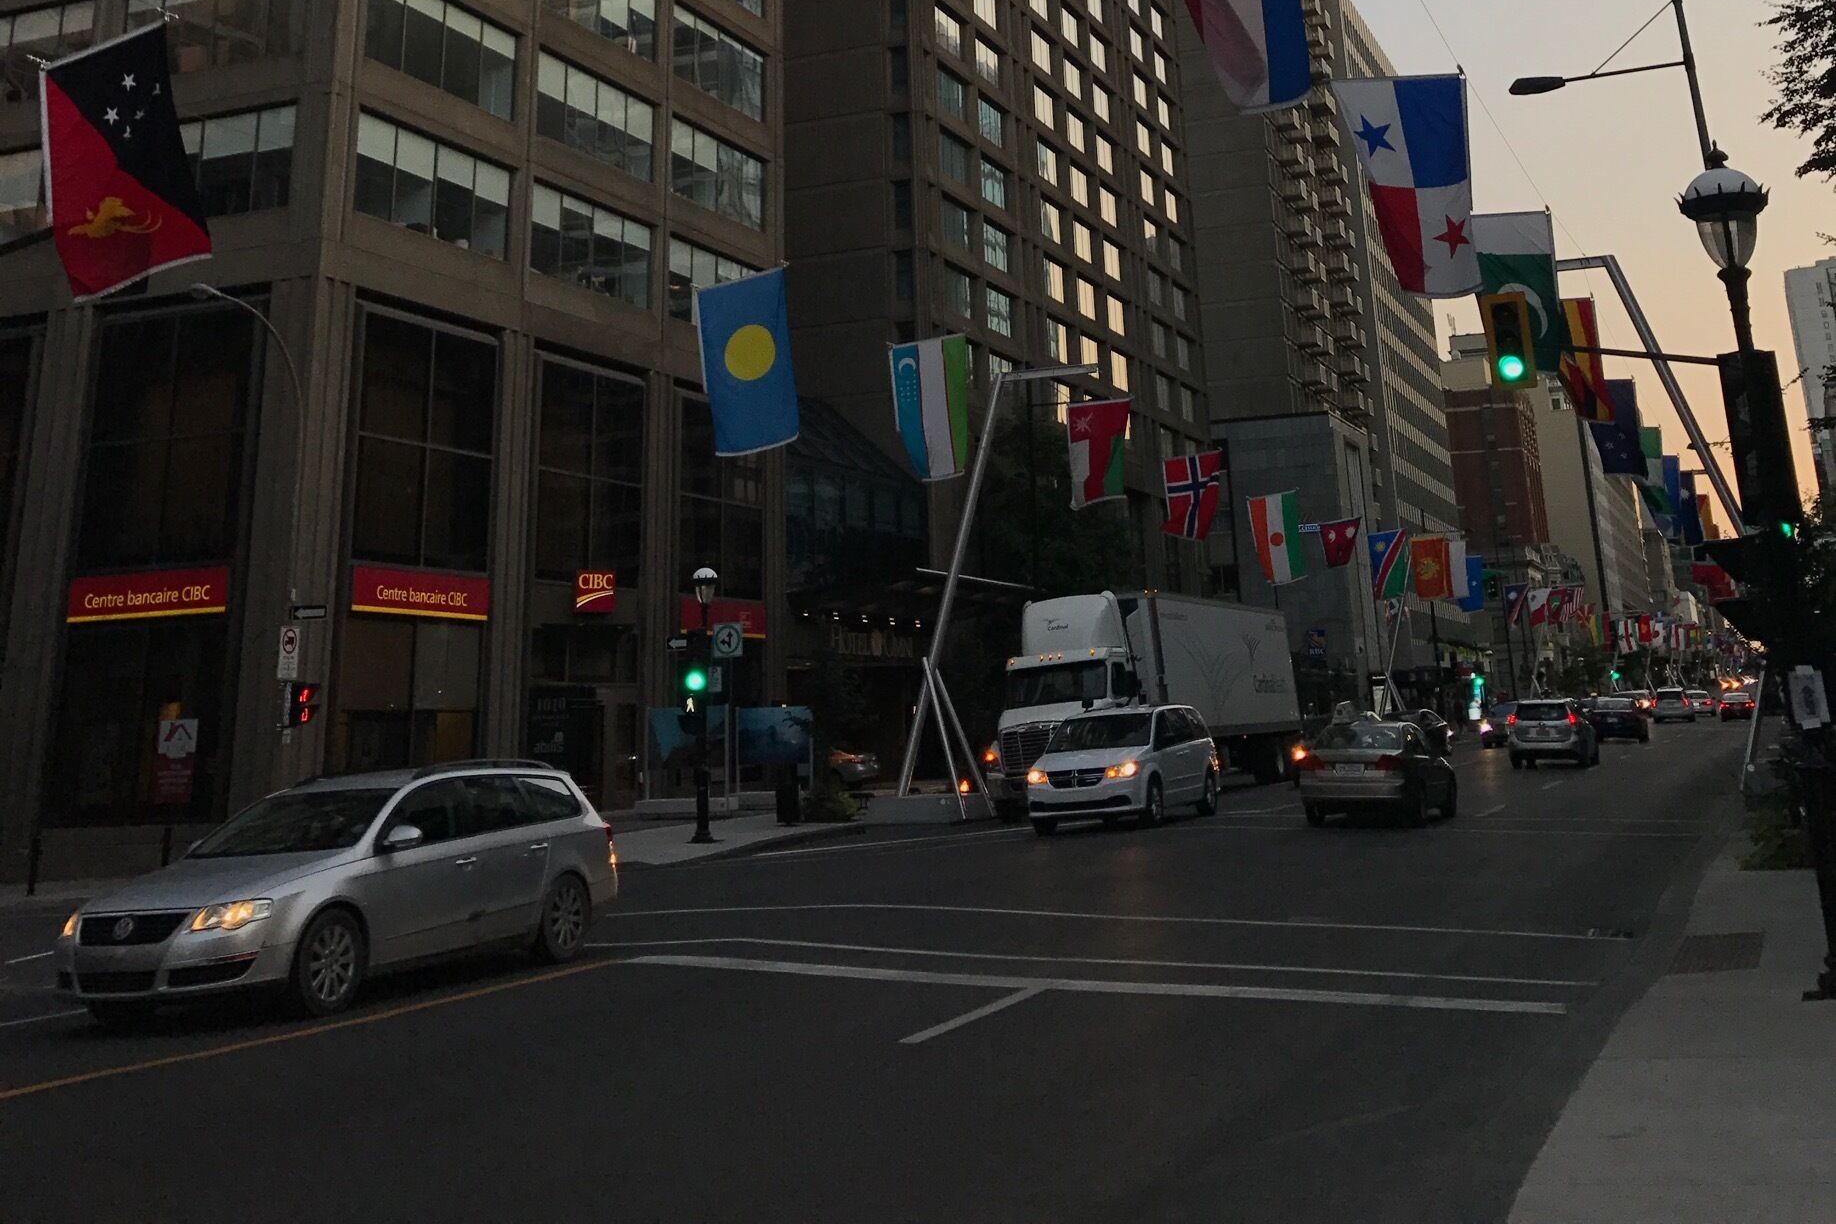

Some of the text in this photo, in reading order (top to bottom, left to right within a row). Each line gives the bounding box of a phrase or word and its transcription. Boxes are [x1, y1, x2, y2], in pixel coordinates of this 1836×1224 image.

[578, 573, 613, 589] CIBC
[84, 584, 211, 608] Centre bancaire CIBC
[376, 584, 468, 606] Centre bancaire CIBC
